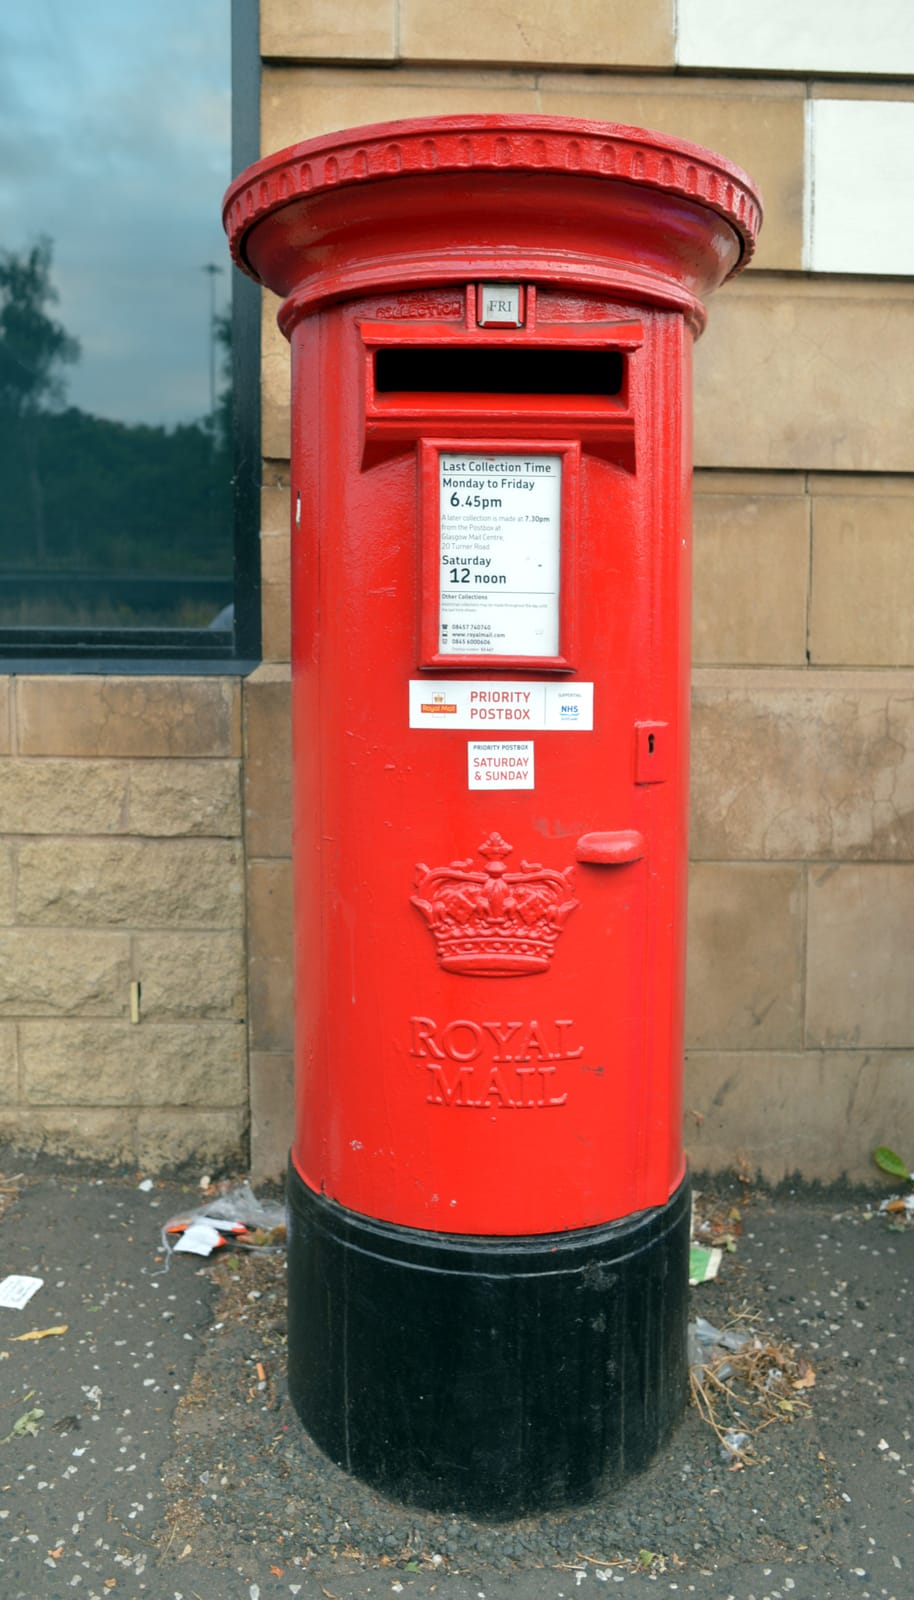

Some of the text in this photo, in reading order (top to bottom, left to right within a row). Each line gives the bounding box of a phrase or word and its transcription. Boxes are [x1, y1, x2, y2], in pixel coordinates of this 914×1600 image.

[489, 300, 512, 312] FRI
[442, 461, 551, 472] Last Collection Time
[442, 478, 535, 491] Monday to Friday
[450, 491, 502, 510] 6.45pm
[525, 515, 550, 523] 7.30pm
[442, 533, 467, 542] Glasgow
[442, 555, 491, 567] Saturday
[449, 568, 506, 584] 12 noon
[470, 691, 531, 703] PRIORITY
[423, 704, 456, 713] Royal Mail
[470, 708, 531, 720] POSTBOX
[561, 705, 578, 713] NHS
[473, 757, 529, 768] SATURDAY
[474, 771, 529, 781] & SUNDAY
[409, 1016, 584, 1062] ROYAL
[426, 1063, 568, 1109] MAIL
